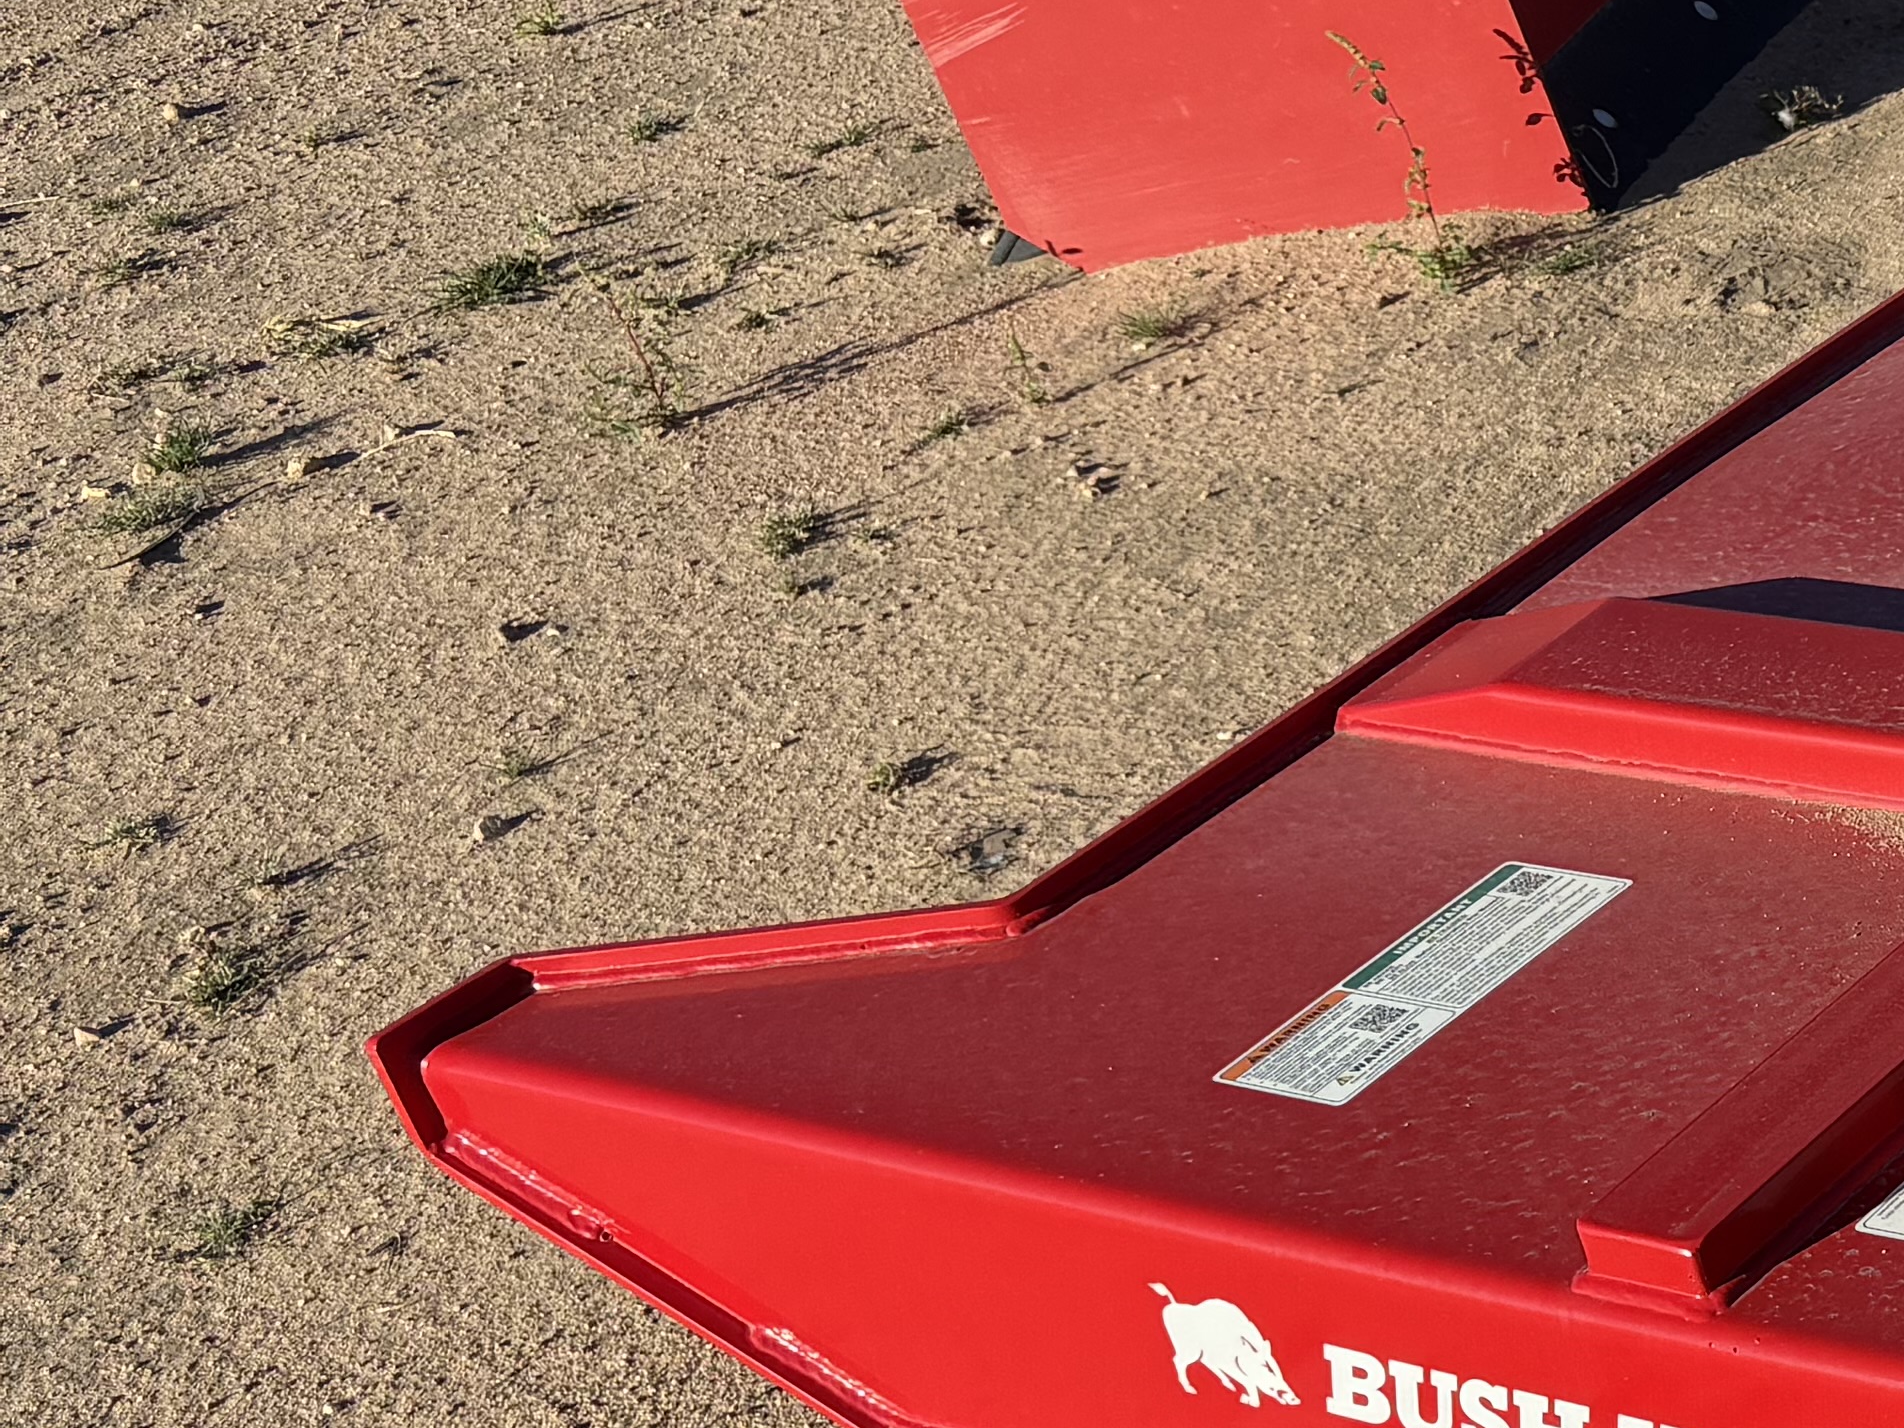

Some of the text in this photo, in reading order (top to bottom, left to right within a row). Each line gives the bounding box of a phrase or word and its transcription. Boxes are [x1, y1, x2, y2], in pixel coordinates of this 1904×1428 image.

[1393, 897, 1473, 956] IMPORTANT
[1265, 1001, 1332, 1054] WARNING
[1351, 1022, 1420, 1073] WARNING
